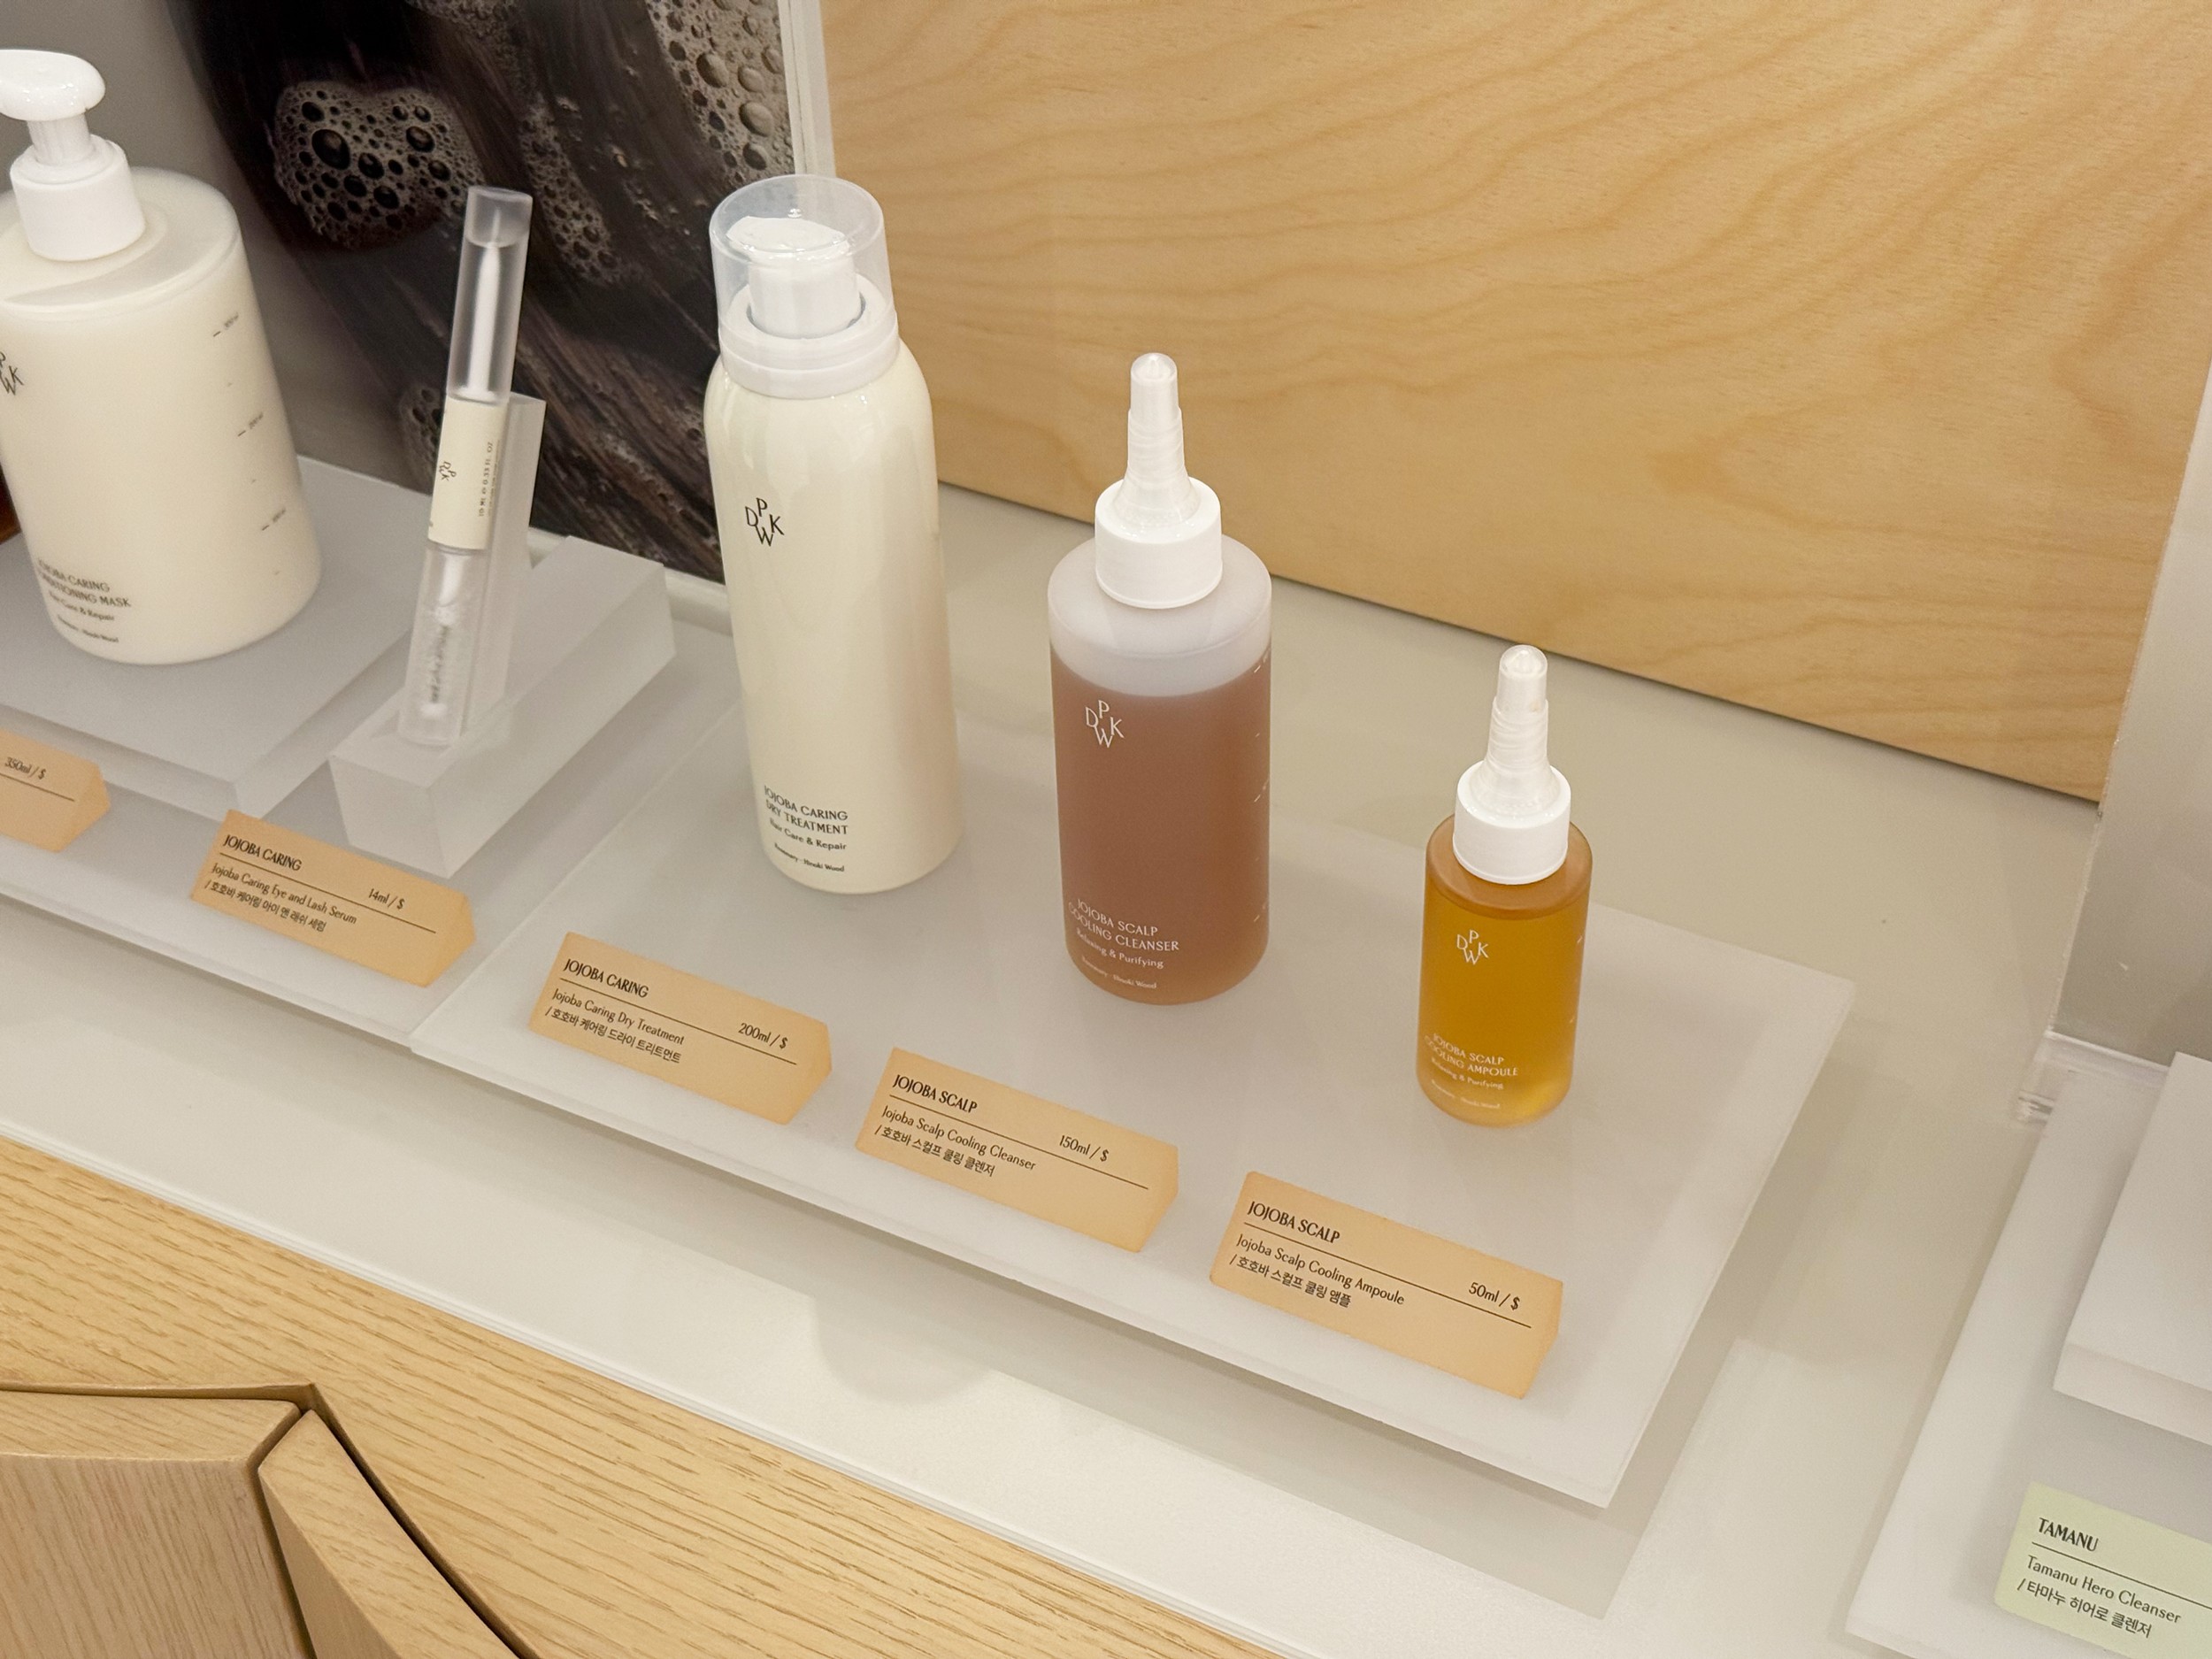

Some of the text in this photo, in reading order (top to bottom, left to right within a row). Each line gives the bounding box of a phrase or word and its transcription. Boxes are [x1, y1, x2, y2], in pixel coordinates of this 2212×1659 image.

[68, 574, 110, 593] CARING
[99, 595, 131, 607] MASK
[4, 757, 33, 774] 350ml
[764, 785, 849, 821] JOJOBA CARING
[765, 799, 849, 834] DRY TREATMENT
[222, 834, 303, 872] JOJOBA CARING
[784, 828, 804, 842] Care
[806, 837, 813, 846] &
[816, 839, 847, 851] Repair
[211, 863, 357, 925] Jojoba Caring Eye and Lash Serum
[211, 881, 236, 898] 호호바
[263, 900, 280, 915] 아이
[368, 887, 390, 905] 14ml
[1069, 902, 1179, 951] COOLING CLEANSER
[1078, 899, 1158, 936] JOJOBA SCALP
[1109, 949, 1117, 958] &
[1118, 952, 1164, 970] Purifying
[563, 958, 649, 998] JOJOBA CARING
[552, 987, 685, 1045] Jojoba Caring Dry Treatment
[551, 1008, 580, 1026] 호호바
[580, 1018, 608, 1037] 케어링
[608, 1028, 637, 1048] 드라이
[635, 1039, 681, 1064] 트리트먼트
[738, 1022, 772, 1043] 200ml
[779, 1036, 788, 1050] $
[1433, 1033, 1504, 1065] JOJOBA SCALP
[1467, 1077, 1503, 1090] Purifying
[1468, 1064, 1518, 1077] AMPOULE
[893, 1074, 978, 1114] JOJOBA SCALP
[881, 1105, 1036, 1171] Jojoba Scalp Cooling Cleanser
[881, 1126, 912, 1146] 호호바
[911, 1139, 942, 1157] 스컬프
[942, 1148, 964, 1166] 쿨링
[964, 1156, 996, 1178] 클렌저
[1059, 1134, 1091, 1156] 150ml
[1099, 1148, 1110, 1163] $
[1247, 1201, 1340, 1244] JOJOBA SCALP
[1236, 1233, 1405, 1306] Jojoba Scalp Cooling Ampoule
[1237, 1256, 1270, 1278] 호호바
[1271, 1269, 1303, 1290] 스컬프
[1305, 1280, 1327, 1299] 쿨링
[1329, 1289, 1352, 1309] 앰플
[1469, 1281, 1500, 1303] 50ml
[1510, 1296, 1520, 1311] $
[2038, 1517, 2100, 1552] TAMANU
[2027, 1555, 2182, 1624] Tamanu Hero Cleanser
[2026, 1579, 2067, 1606] 타마누
[2070, 1596, 2109, 1622] 히어로
[2110, 1612, 2153, 1639] 클렌저
